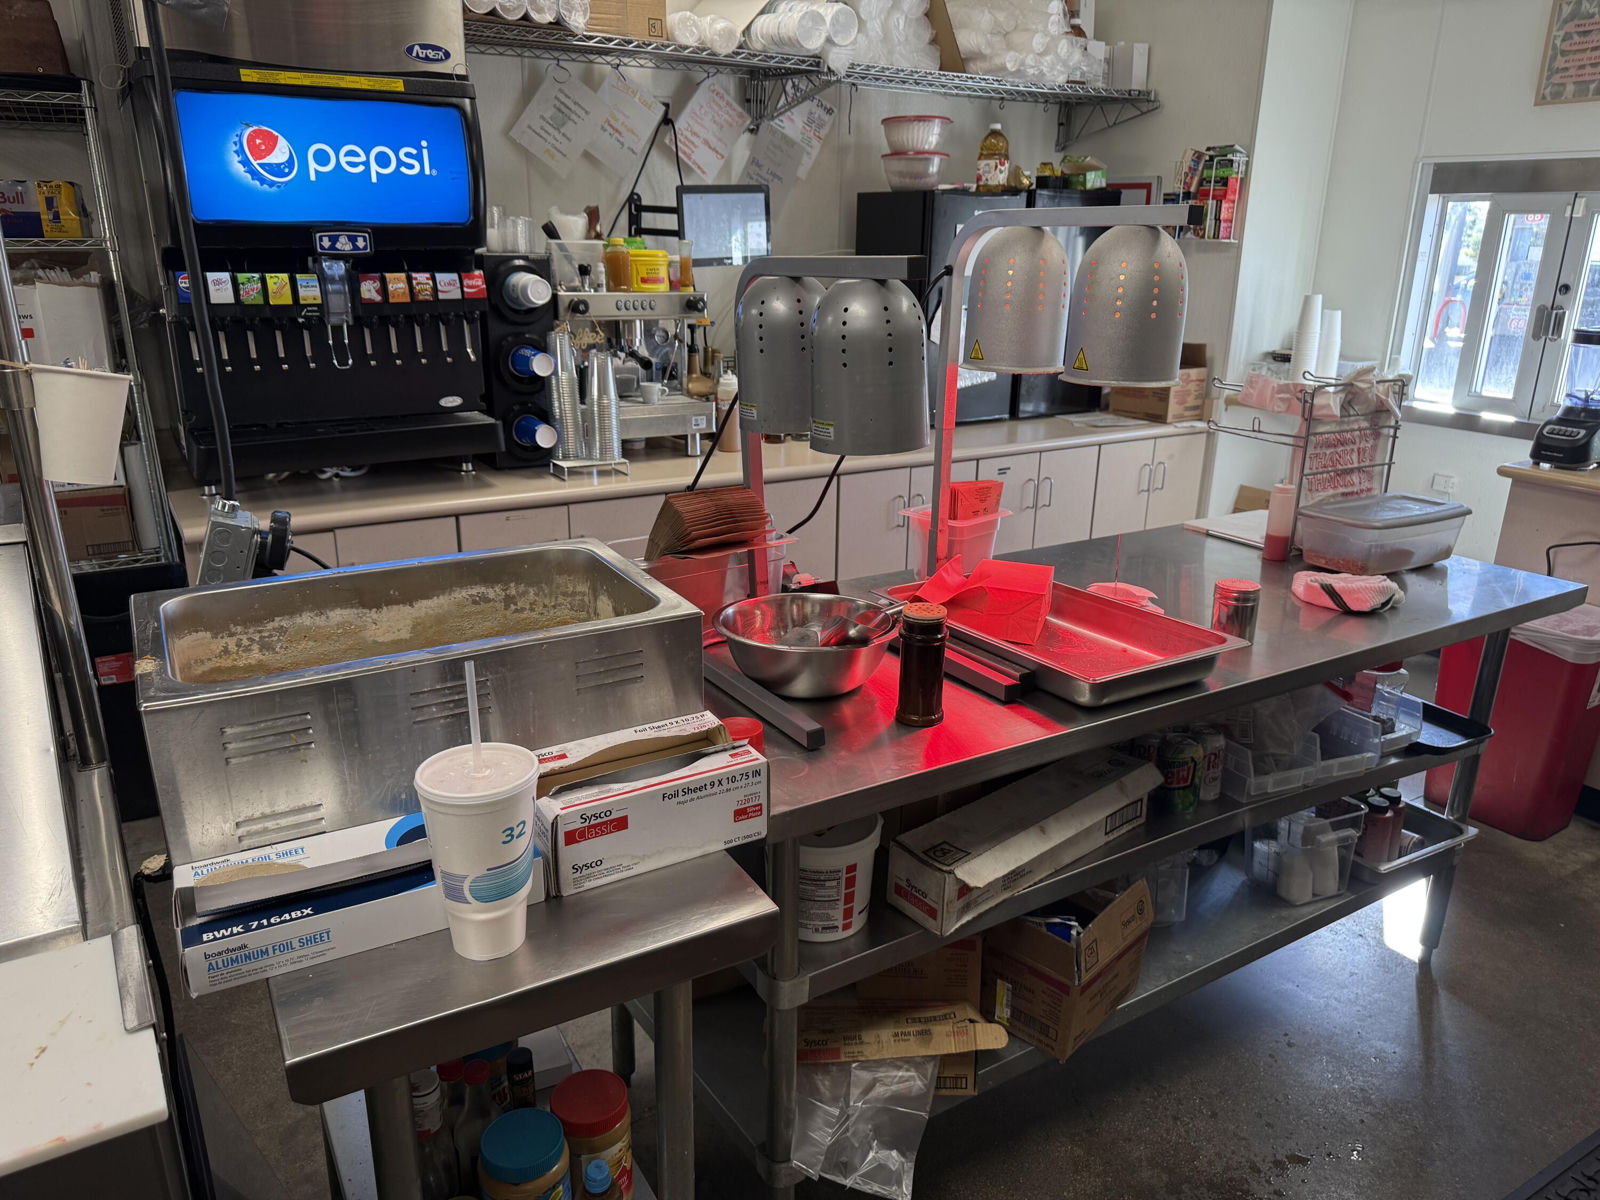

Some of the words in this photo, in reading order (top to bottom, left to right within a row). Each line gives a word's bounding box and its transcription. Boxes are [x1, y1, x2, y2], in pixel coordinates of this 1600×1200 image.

[307, 139, 431, 183] pepsi
[1313, 432, 1357, 449] THANK
[1308, 449, 1355, 470] THANK
[1306, 468, 1355, 492] THANK
[661, 790, 679, 802] Foil
[681, 783, 708, 797] Sheet
[709, 780, 716, 789] 9
[716, 778, 724, 788] X
[726, 771, 750, 785] 10.75
[751, 768, 762, 779] IN
[736, 794, 761, 806] 7220177
[580, 809, 613, 825] Sysco
[501, 819, 527, 845] 32
[575, 821, 619, 842] Classic
[723, 838, 734, 846] 500
[275, 846, 306, 859] SHEET
[572, 858, 603, 875] Sysco
[202, 925, 245, 941] BWK
[248, 906, 315, 930] 7164BX
[203, 943, 249, 960] boardwalk
[207, 947, 270, 972] ALUMINUM
[272, 941, 296, 955] FOIL
[298, 930, 331, 948] SHEET
[803, 1038, 828, 1049] Sysco
